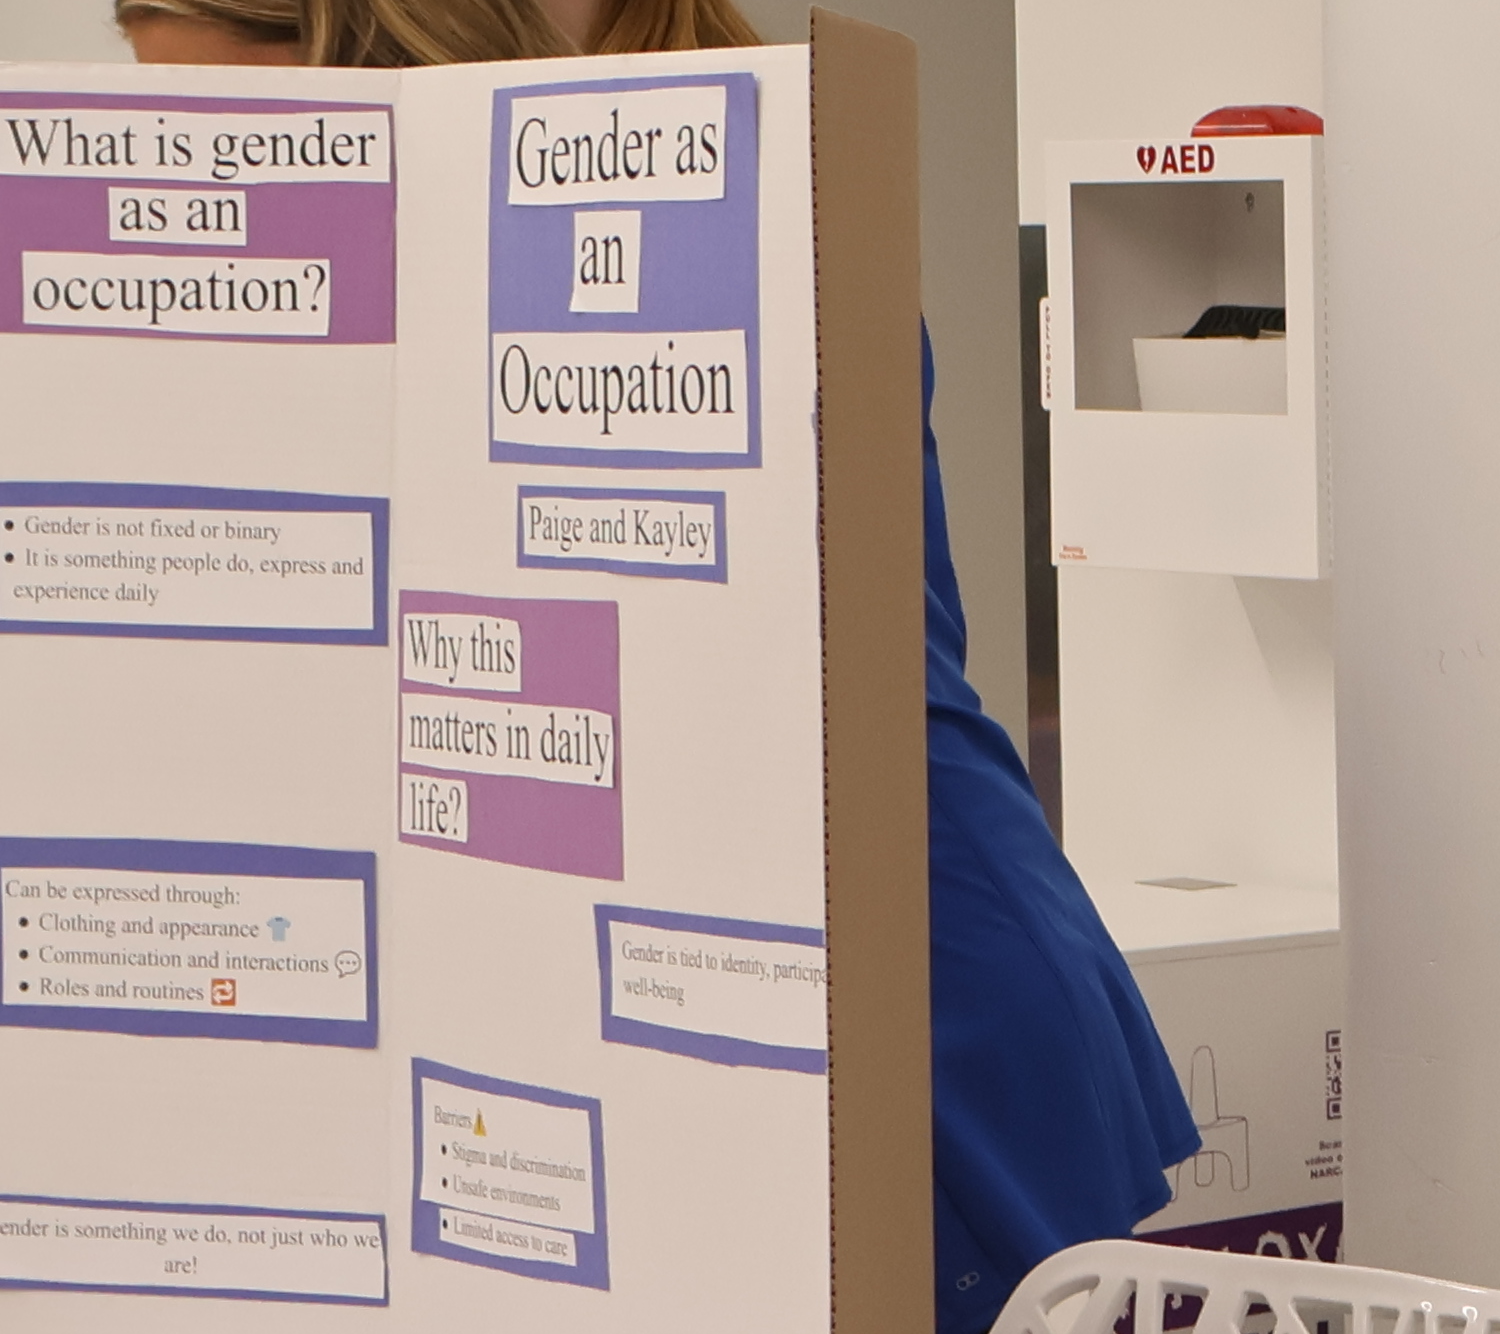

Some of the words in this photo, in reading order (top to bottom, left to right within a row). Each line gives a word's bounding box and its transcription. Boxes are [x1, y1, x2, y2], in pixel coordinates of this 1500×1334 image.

[4, 116, 136, 166] What
[155, 116, 193, 166] is
[210, 116, 376, 181] gender
[515, 107, 663, 188] Gender
[674, 122, 718, 175] as
[1160, 144, 1215, 175] AED
[118, 197, 167, 232] as
[185, 197, 241, 232] an
[579, 234, 625, 285] an
[32, 262, 326, 325] occupation?
[499, 339, 734, 435] Occupation
[23, 514, 91, 536] Gender
[95, 516, 111, 536] is
[115, 520, 144, 537] not
[149, 517, 195, 538] fixed
[199, 524, 220, 539] or
[223, 519, 281, 546] binary
[528, 504, 583, 553] Paige
[588, 506, 627, 545] and
[631, 508, 712, 559] Kayley
[24, 547, 39, 567] It
[43, 547, 58, 567] is
[63, 548, 157, 575] something
[161, 550, 221, 576] people
[225, 552, 254, 575] do,
[258, 558, 327, 579] express
[330, 555, 364, 575] and
[12, 580, 110, 604] experience
[114, 581, 159, 607] daily
[406, 618, 463, 684] Why
[469, 620, 516, 674] this
[408, 711, 497, 757] matters
[505, 707, 531, 761] in
[539, 711, 614, 782] daily
[409, 780, 461, 835] life?
[3, 878, 41, 898] Can
[45, 879, 68, 899] be
[71, 882, 161, 905] expressed
[165, 883, 240, 909] through:
[37, 911, 116, 939] Clothing
[119, 914, 154, 935] and
[158, 920, 260, 941] appearance
[37, 944, 182, 968] Communication
[186, 949, 219, 969] and
[224, 949, 330, 973] interactions
[39, 976, 90, 997] Roles
[93, 978, 128, 999] and
[131, 979, 205, 1001] routines
